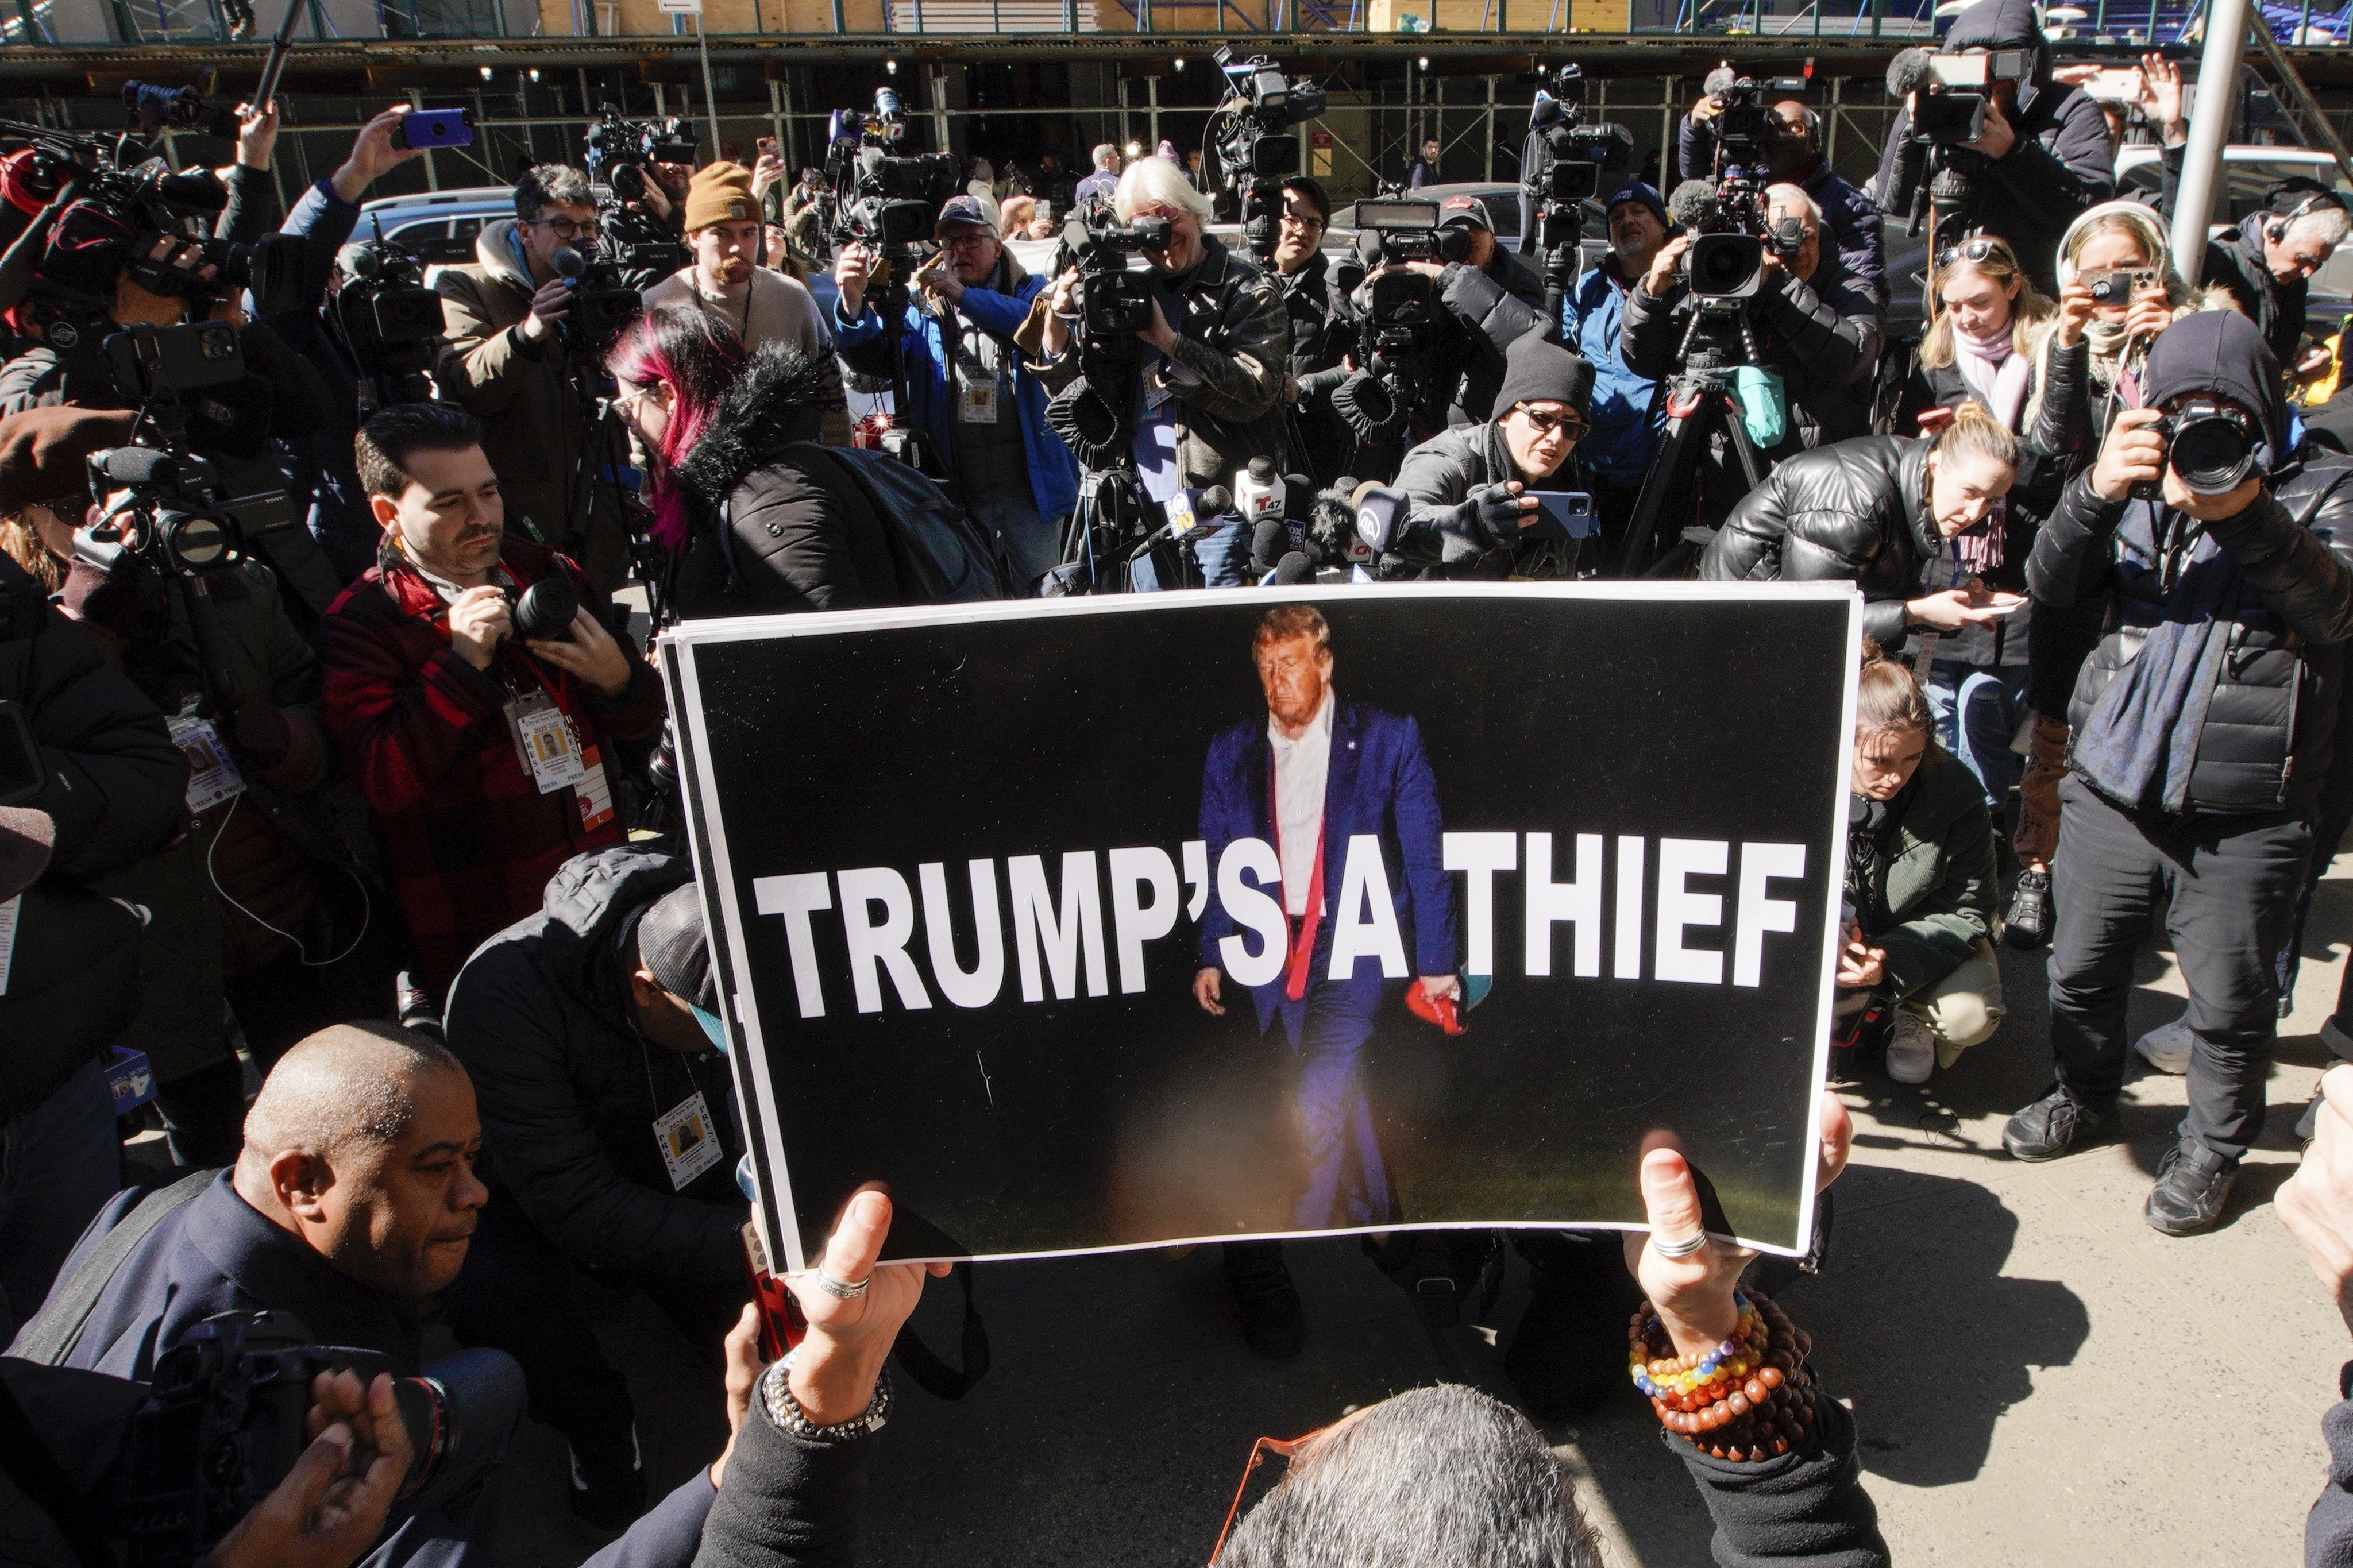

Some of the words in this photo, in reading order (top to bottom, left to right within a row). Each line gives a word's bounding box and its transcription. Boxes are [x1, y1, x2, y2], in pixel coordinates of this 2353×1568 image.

[265, 496, 286, 504] SONY
[1253, 508, 1283, 519] TELEMUNDO
[1267, 500, 1282, 510] 47
[1164, 499, 1181, 538] NEWS
[1176, 511, 1195, 533] 2
[1287, 525, 1303, 536] OX
[523, 732, 541, 777] PRESS
[754, 838, 1287, 1018] TRUMP'S
[1328, 835, 1409, 980] A
[1443, 832, 1806, 987] THIEF
[699, 1105, 716, 1145] PRESS
[659, 1134, 677, 1175] PRESS
